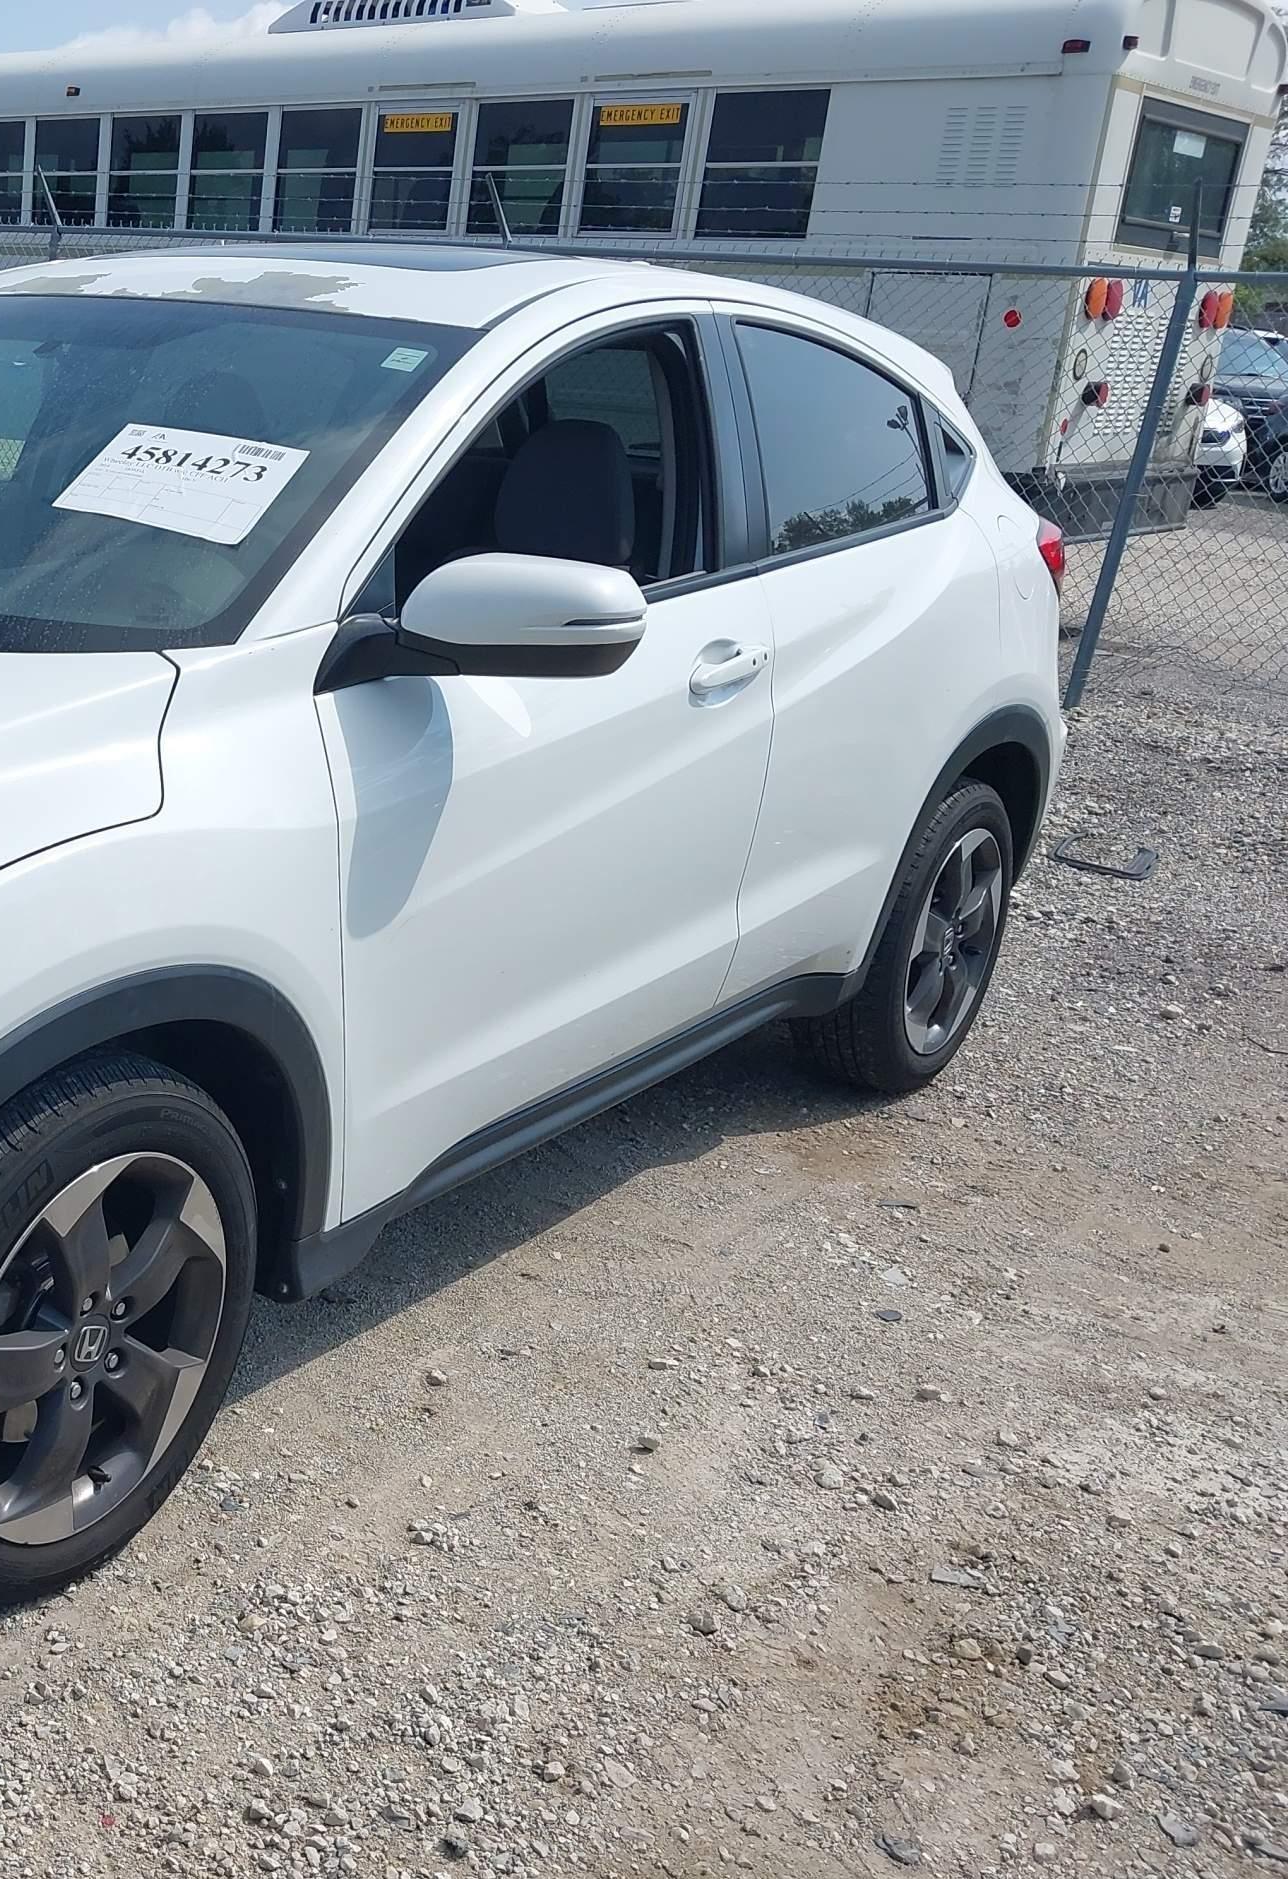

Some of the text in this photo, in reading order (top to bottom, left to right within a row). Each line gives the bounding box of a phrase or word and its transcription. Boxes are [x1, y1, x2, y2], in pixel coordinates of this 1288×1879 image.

[600, 106, 680, 121] EMERGENCY EXIT
[385, 116, 451, 129] EMERGENCY EXIT
[121, 445, 268, 482] 45814273
